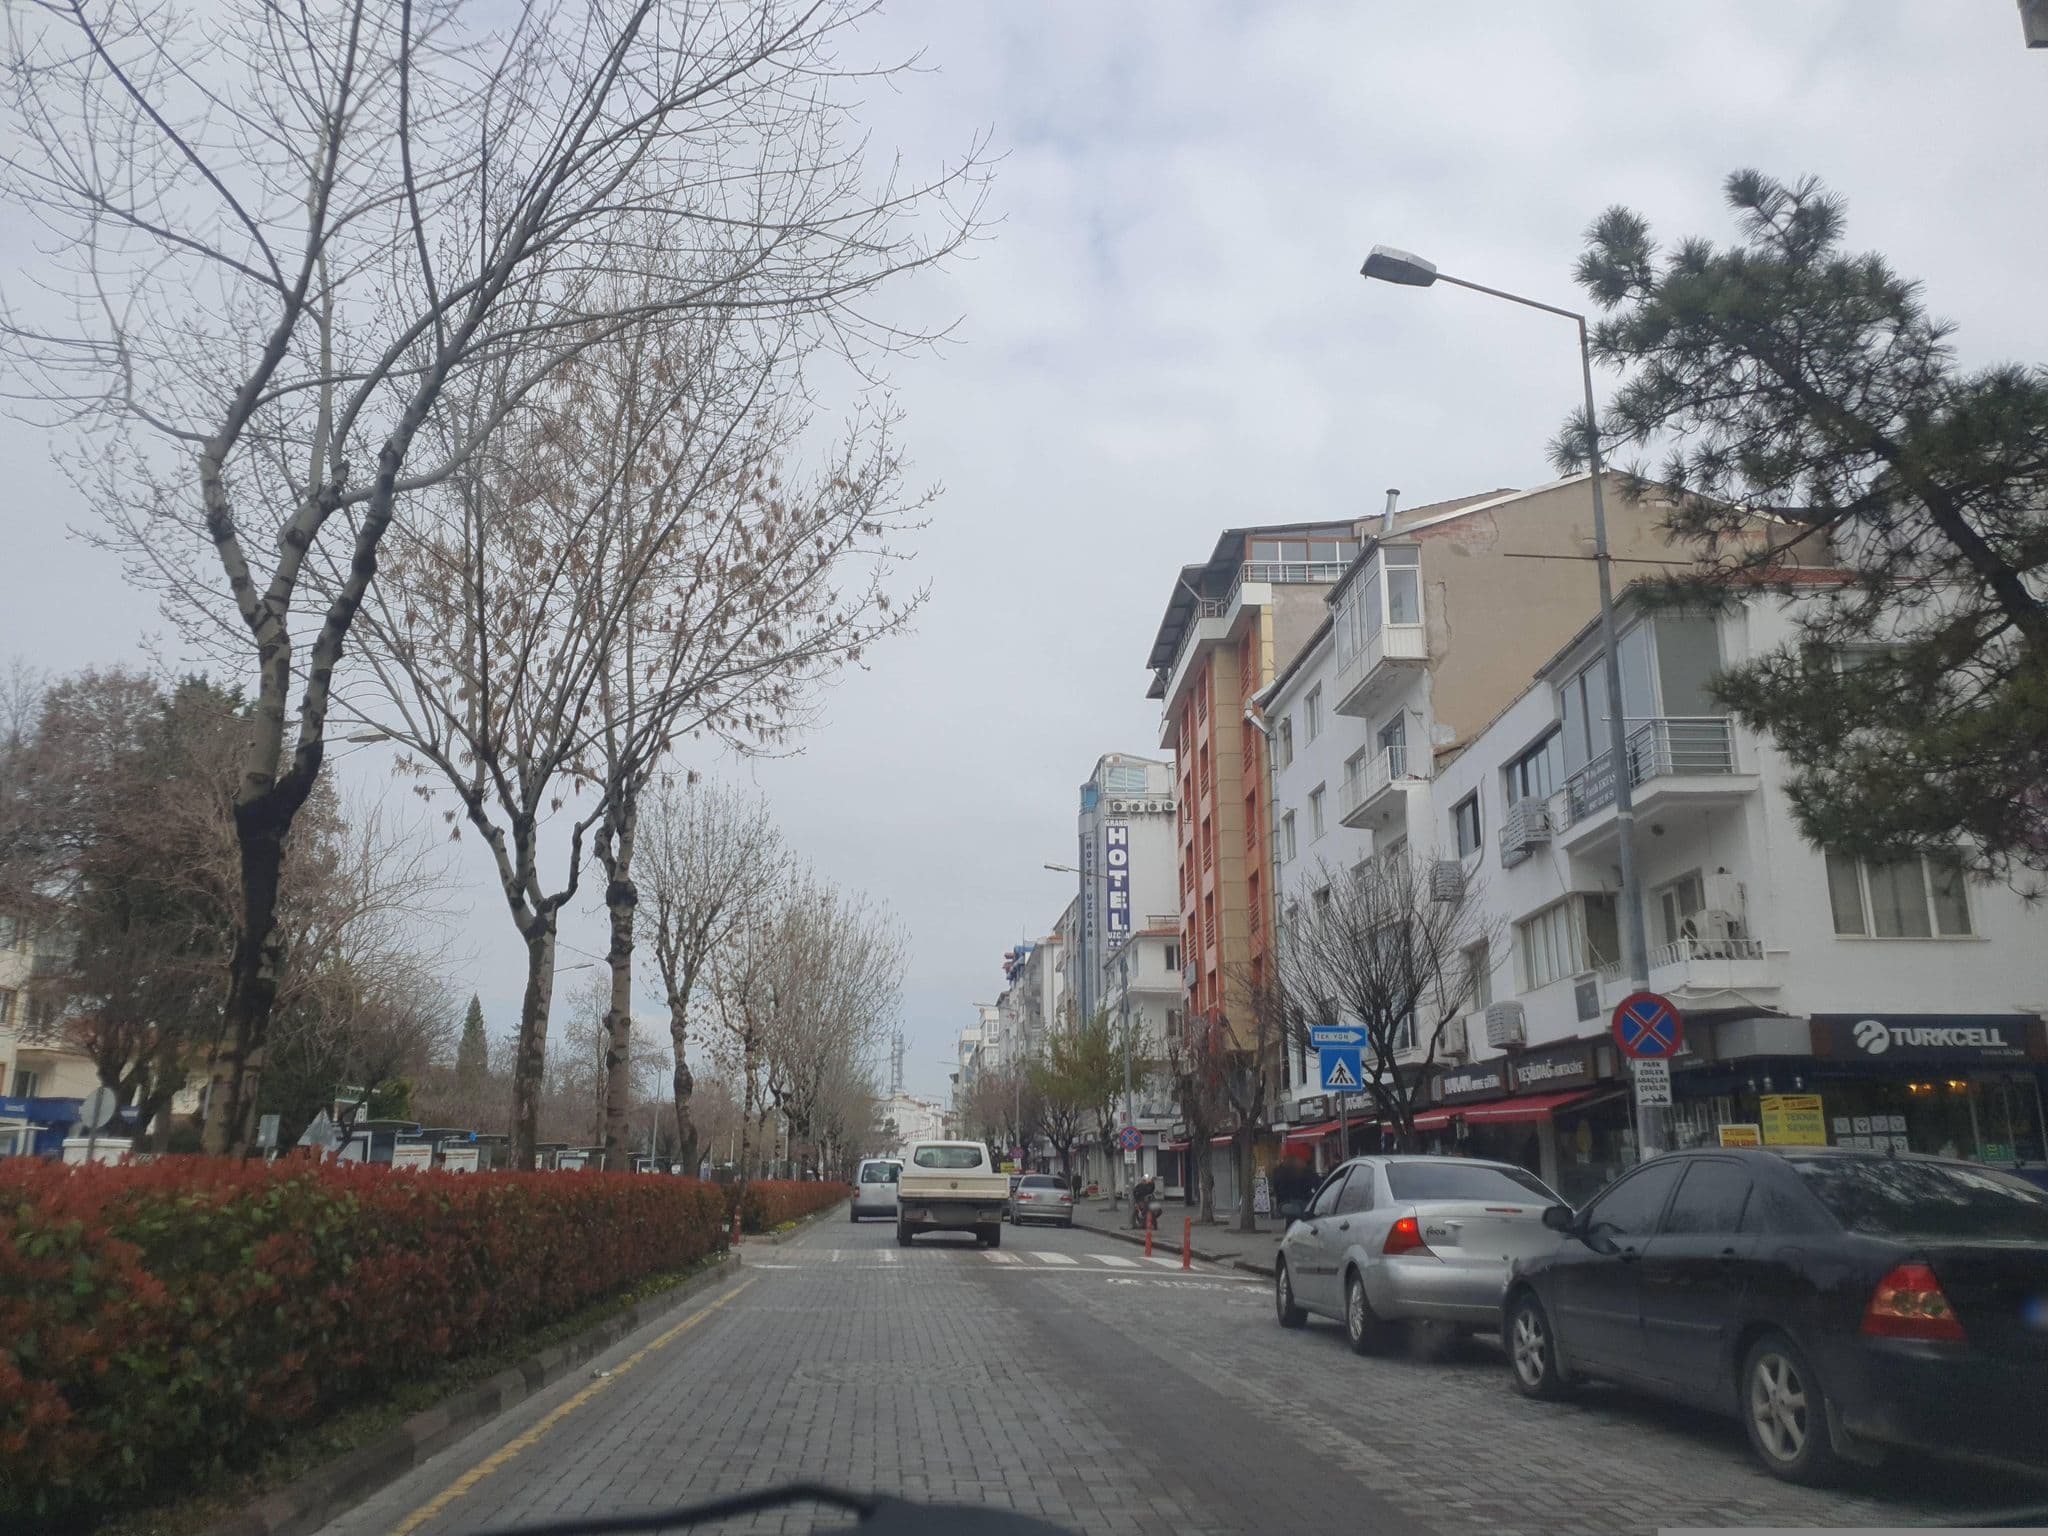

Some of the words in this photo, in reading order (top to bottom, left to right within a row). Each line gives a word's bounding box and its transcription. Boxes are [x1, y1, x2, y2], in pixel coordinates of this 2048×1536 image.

[1105, 819, 1128, 827] GRAND
[1107, 827, 1128, 931] HOTEL
[1107, 931, 1130, 939] UZCN
[1334, 1032, 1349, 1040] YÖN
[1889, 1028, 2008, 1047] TURKCELL
